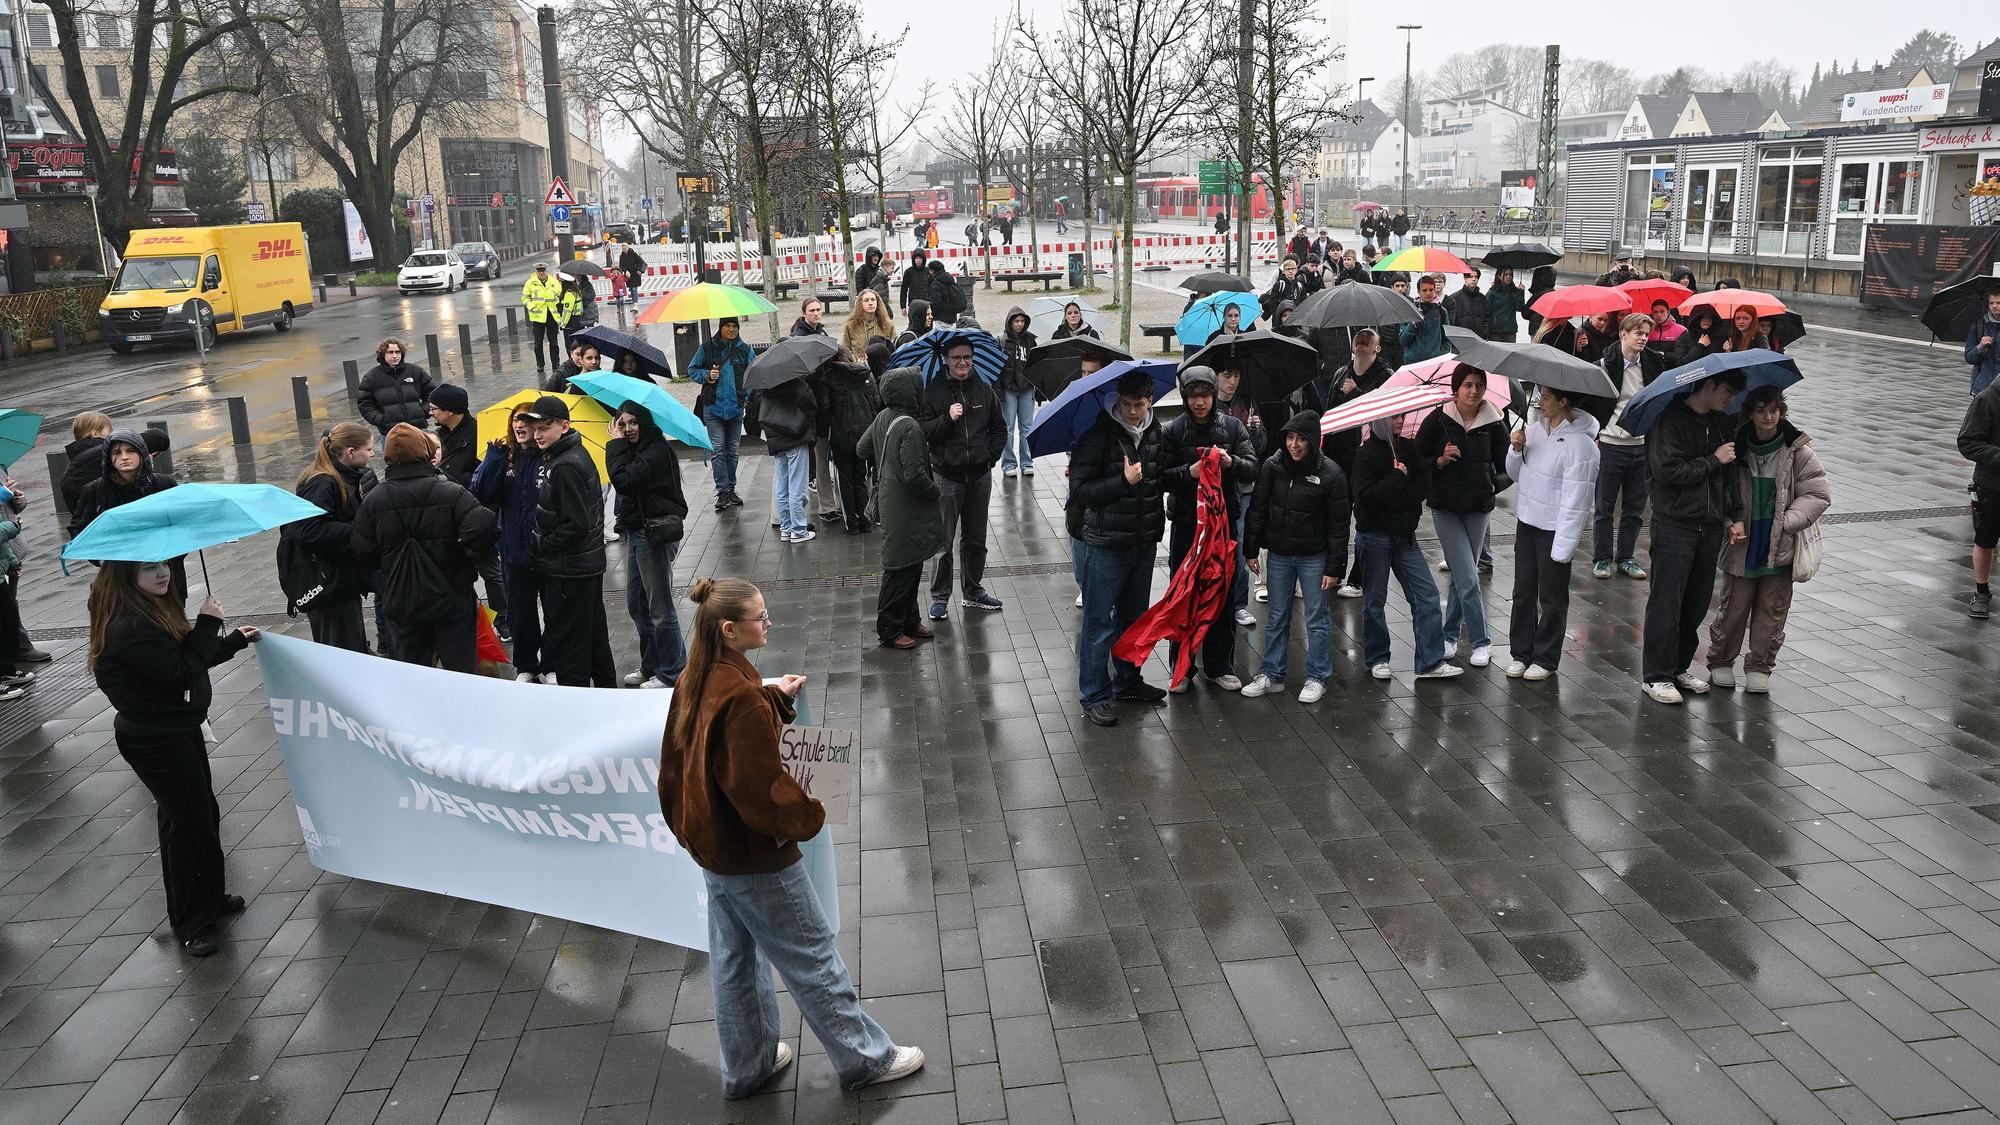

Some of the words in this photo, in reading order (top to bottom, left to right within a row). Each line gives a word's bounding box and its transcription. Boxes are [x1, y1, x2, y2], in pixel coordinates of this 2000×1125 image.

[1879, 90, 1909, 104] wupsi
[1933, 89, 1945, 99] DB
[1862, 104, 1923, 116] KundenCenter
[1921, 128, 1977, 149] Stehcafe
[1982, 126, 1993, 142] &
[37, 168, 83, 179] Kebaphaus
[143, 236, 186, 245] DHL
[258, 239, 296, 260] DHL
[296, 584, 323, 606] adidas
[781, 728, 825, 762] Schule
